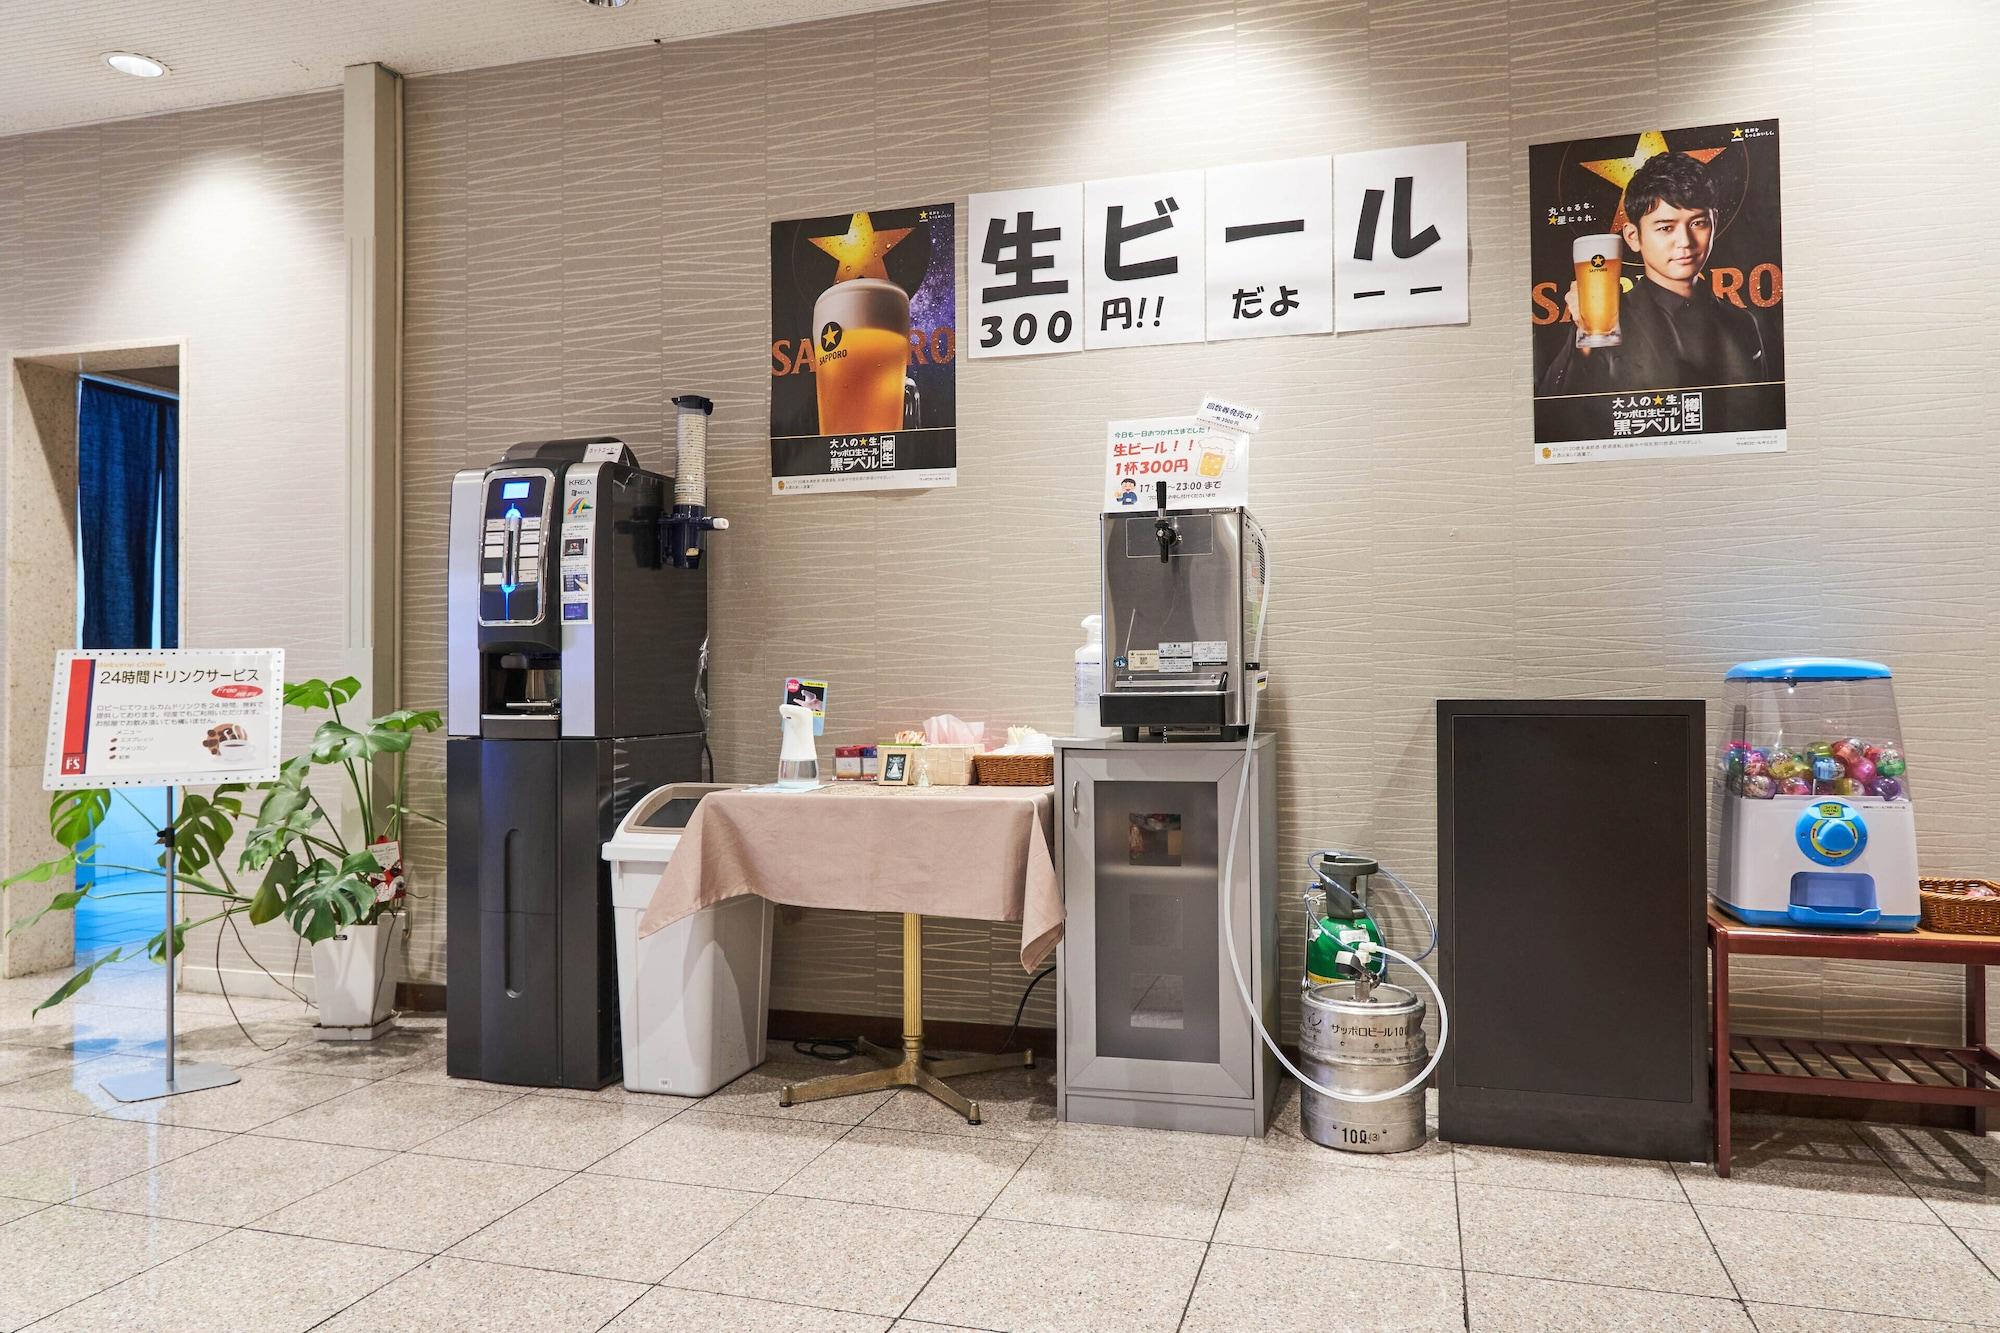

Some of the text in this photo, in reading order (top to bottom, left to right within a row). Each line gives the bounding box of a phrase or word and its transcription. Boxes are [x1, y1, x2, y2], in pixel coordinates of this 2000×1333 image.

[819, 349, 848, 367] SAPPORO
[1612, 407, 1681, 420] サッポロ生ビール
[1613, 416, 1681, 436] 黒ラベル
[830, 447, 880, 458] サッポロ生ビール
[830, 456, 880, 472] 黒ラベル
[1115, 459, 1188, 476] 1杯300円
[100, 669, 260, 685] 24時間ドリンクサービス
[66, 757, 80, 770] FS
